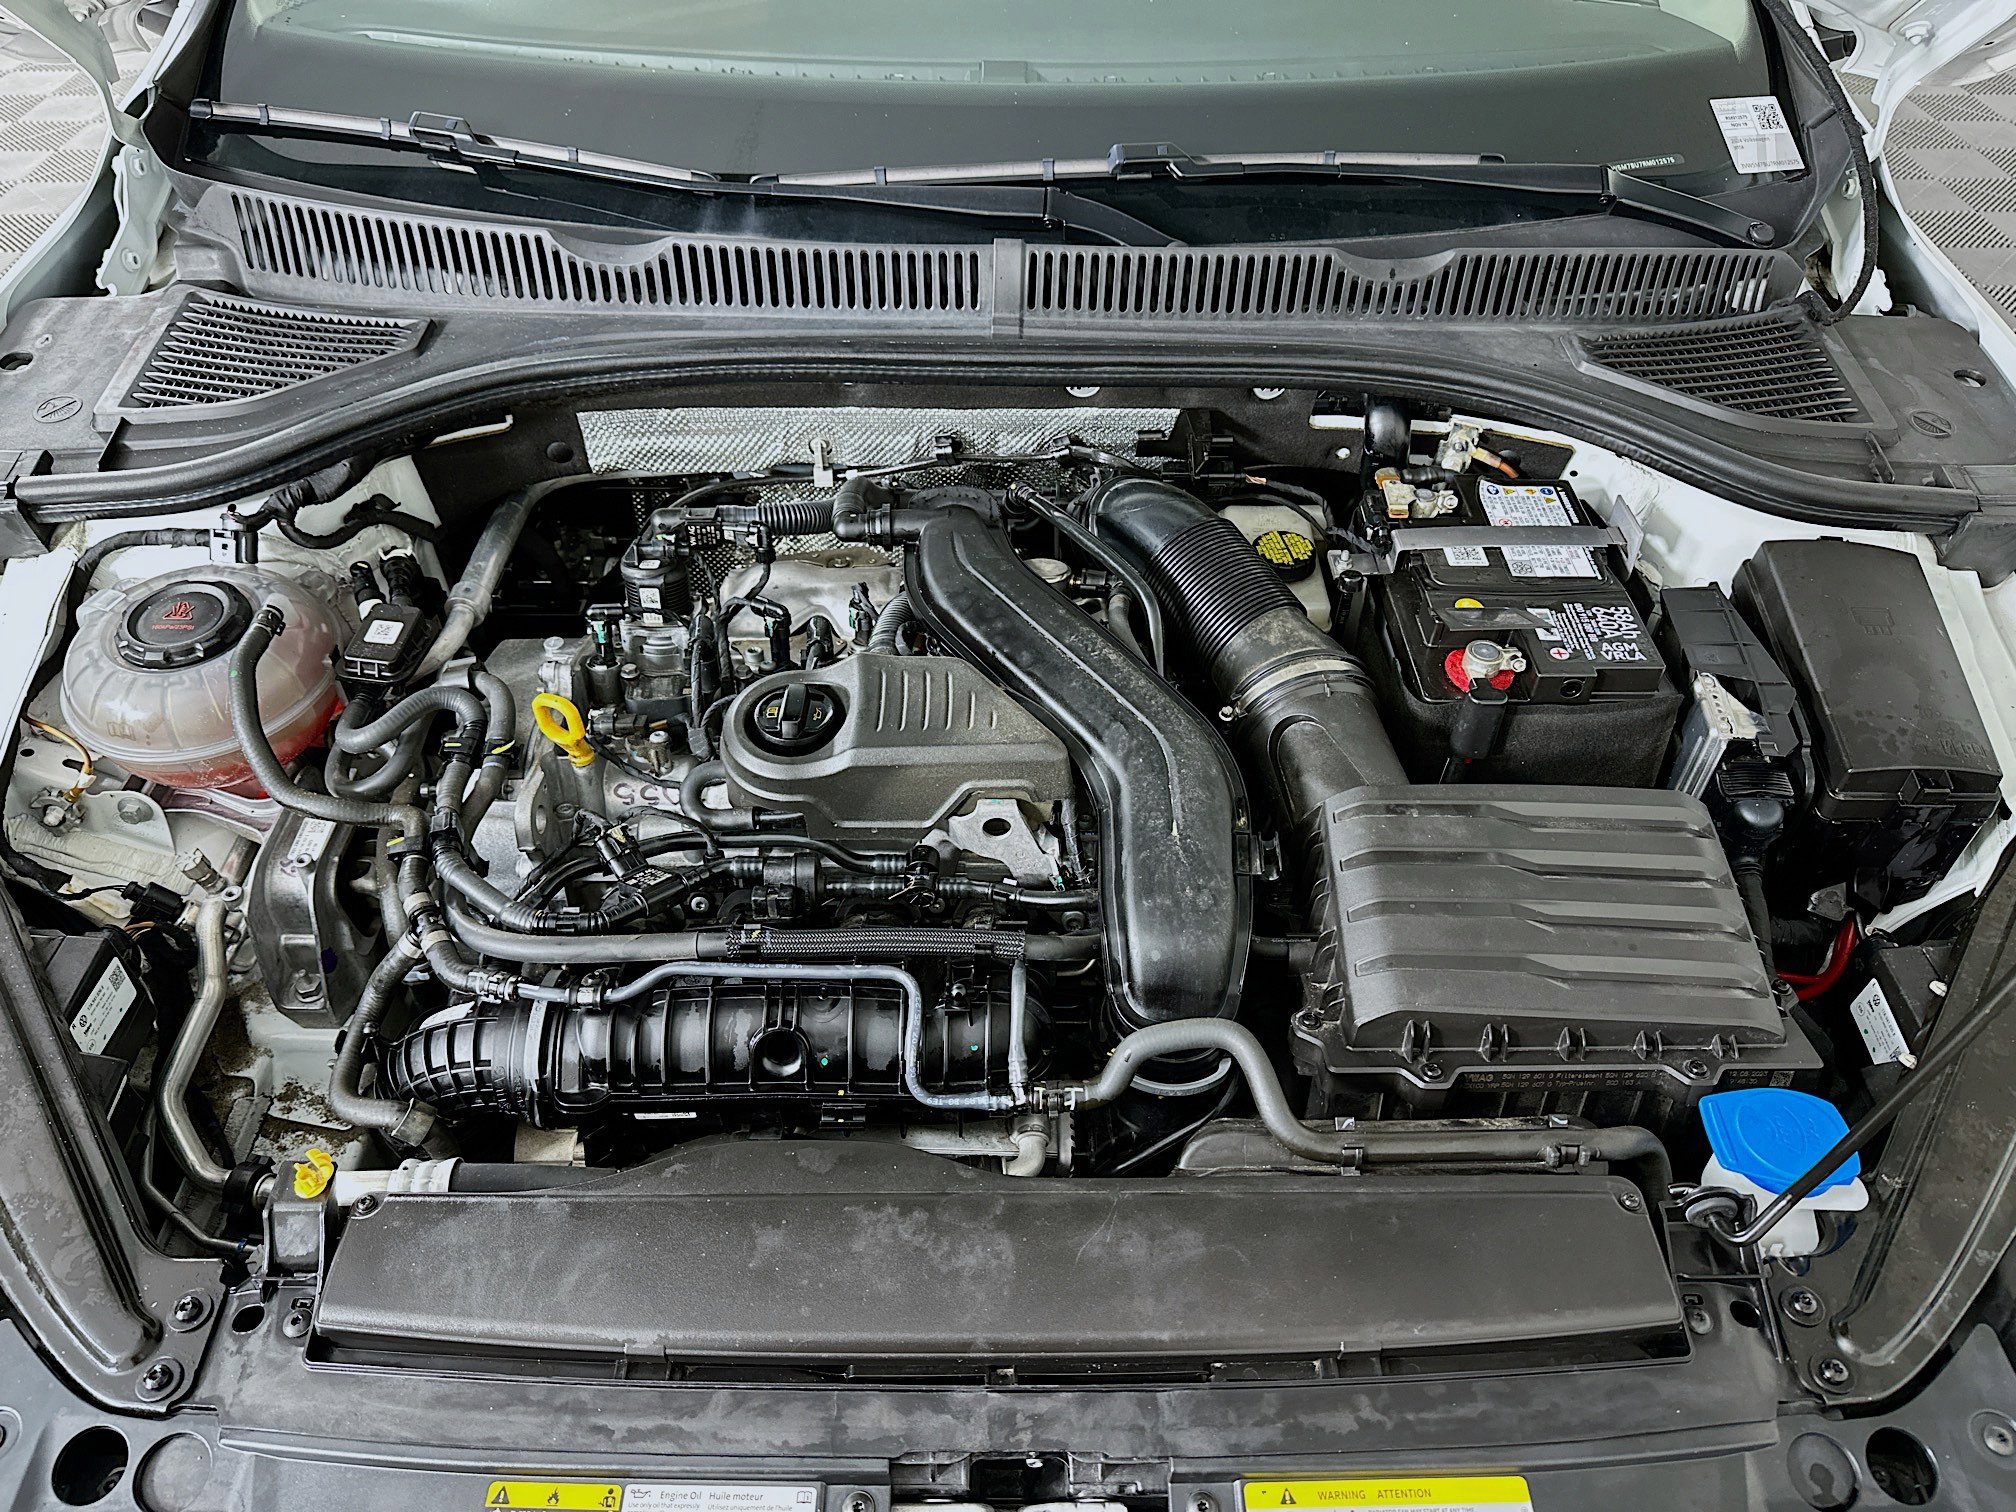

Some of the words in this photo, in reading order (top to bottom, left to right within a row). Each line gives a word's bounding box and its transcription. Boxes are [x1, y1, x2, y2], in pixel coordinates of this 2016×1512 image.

[1591, 606, 1622, 638] 640A
[1610, 606, 1641, 638] 58Ah
[1602, 642, 1639, 652] AGM
[1600, 651, 1648, 660] VRLA
[660, 1491, 688, 1502] Engine
[690, 1491, 702, 1500] Oil
[709, 1492, 731, 1500] Huile
[732, 1492, 764, 1500] moteur
[1317, 1490, 1366, 1500] WARNING
[1377, 1488, 1432, 1499] ATTENTION
